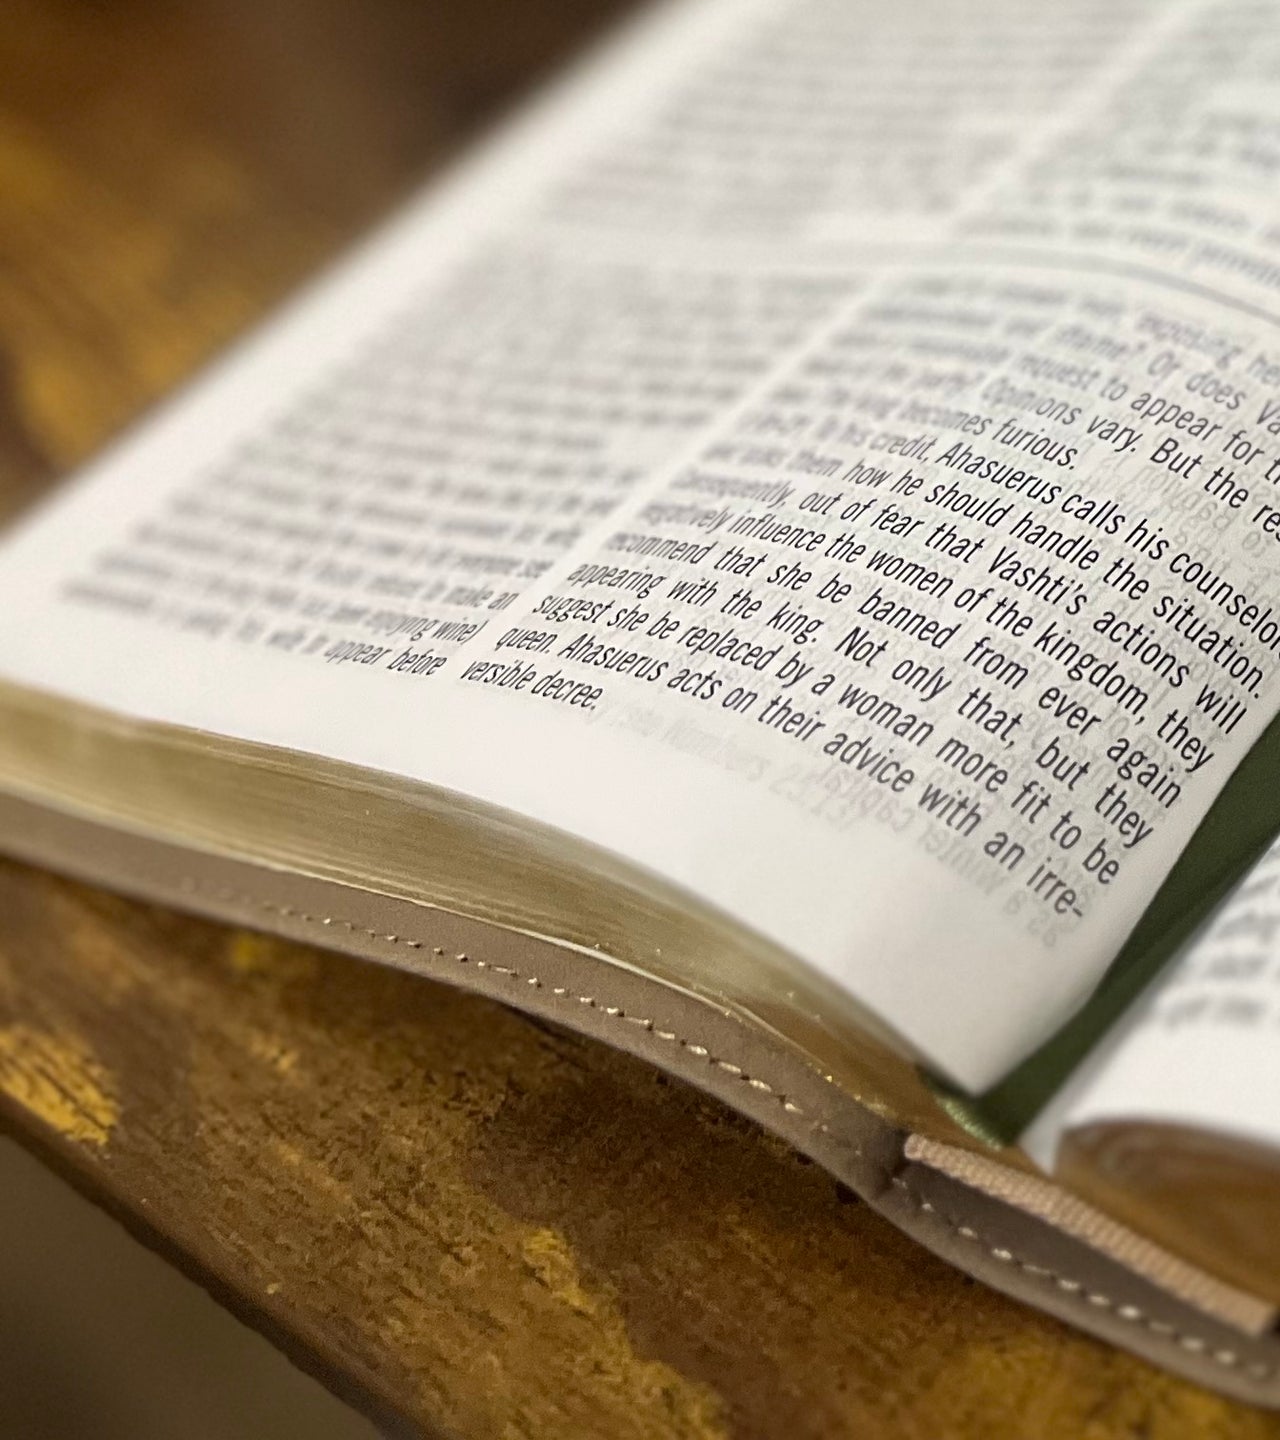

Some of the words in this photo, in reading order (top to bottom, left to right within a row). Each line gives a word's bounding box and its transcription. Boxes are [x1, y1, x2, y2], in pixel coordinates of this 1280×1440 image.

[934, 441, 1063, 505] Ahasuerus
[1060, 493, 1126, 535] calls
[1123, 517, 1170, 561] his
[1086, 416, 1144, 453] vary.
[1149, 436, 1204, 480] But
[1203, 466, 1250, 509] the
[530, 669, 604, 711] decree.
[532, 595, 616, 624] suggest
[606, 603, 650, 632] she
[645, 610, 681, 640] be
[676, 625, 785, 672] replaced
[774, 650, 815, 689] by
[810, 673, 836, 696] a
[837, 683, 935, 747] woman
[935, 737, 1009, 793] more
[557, 632, 670, 682] Ahasuerus
[666, 668, 723, 701] acts
[721, 687, 759, 714] on
[757, 694, 826, 742] their
[713, 545, 769, 578] that
[766, 561, 813, 591] she
[815, 572, 853, 604] be
[857, 587, 963, 650] banned
[962, 635, 1029, 691] from
[1037, 686, 1103, 737] ever
[1106, 737, 1182, 809] again
[823, 532, 867, 564] the
[865, 549, 954, 599] women
[953, 587, 996, 613] of
[985, 596, 1034, 638] the
[1032, 620, 1149, 726] kingdom,
[1156, 708, 1215, 774] they
[839, 498, 878, 523] of
[869, 503, 926, 538] fear
[924, 522, 986, 564] that
[987, 545, 1088, 616] Vashti's
[1092, 610, 1191, 689] actions
[1194, 683, 1248, 735] will
[923, 481, 1016, 528] should
[1008, 510, 1100, 571] handle
[1102, 556, 1150, 601] the
[1152, 595, 1264, 700] situation.
[666, 580, 719, 607] with
[719, 588, 763, 620] the
[765, 601, 825, 646] king.
[833, 625, 889, 668] Not
[891, 659, 953, 703] only
[957, 687, 1023, 750] that,
[1035, 736, 1091, 792] but
[1094, 782, 1154, 850] they
